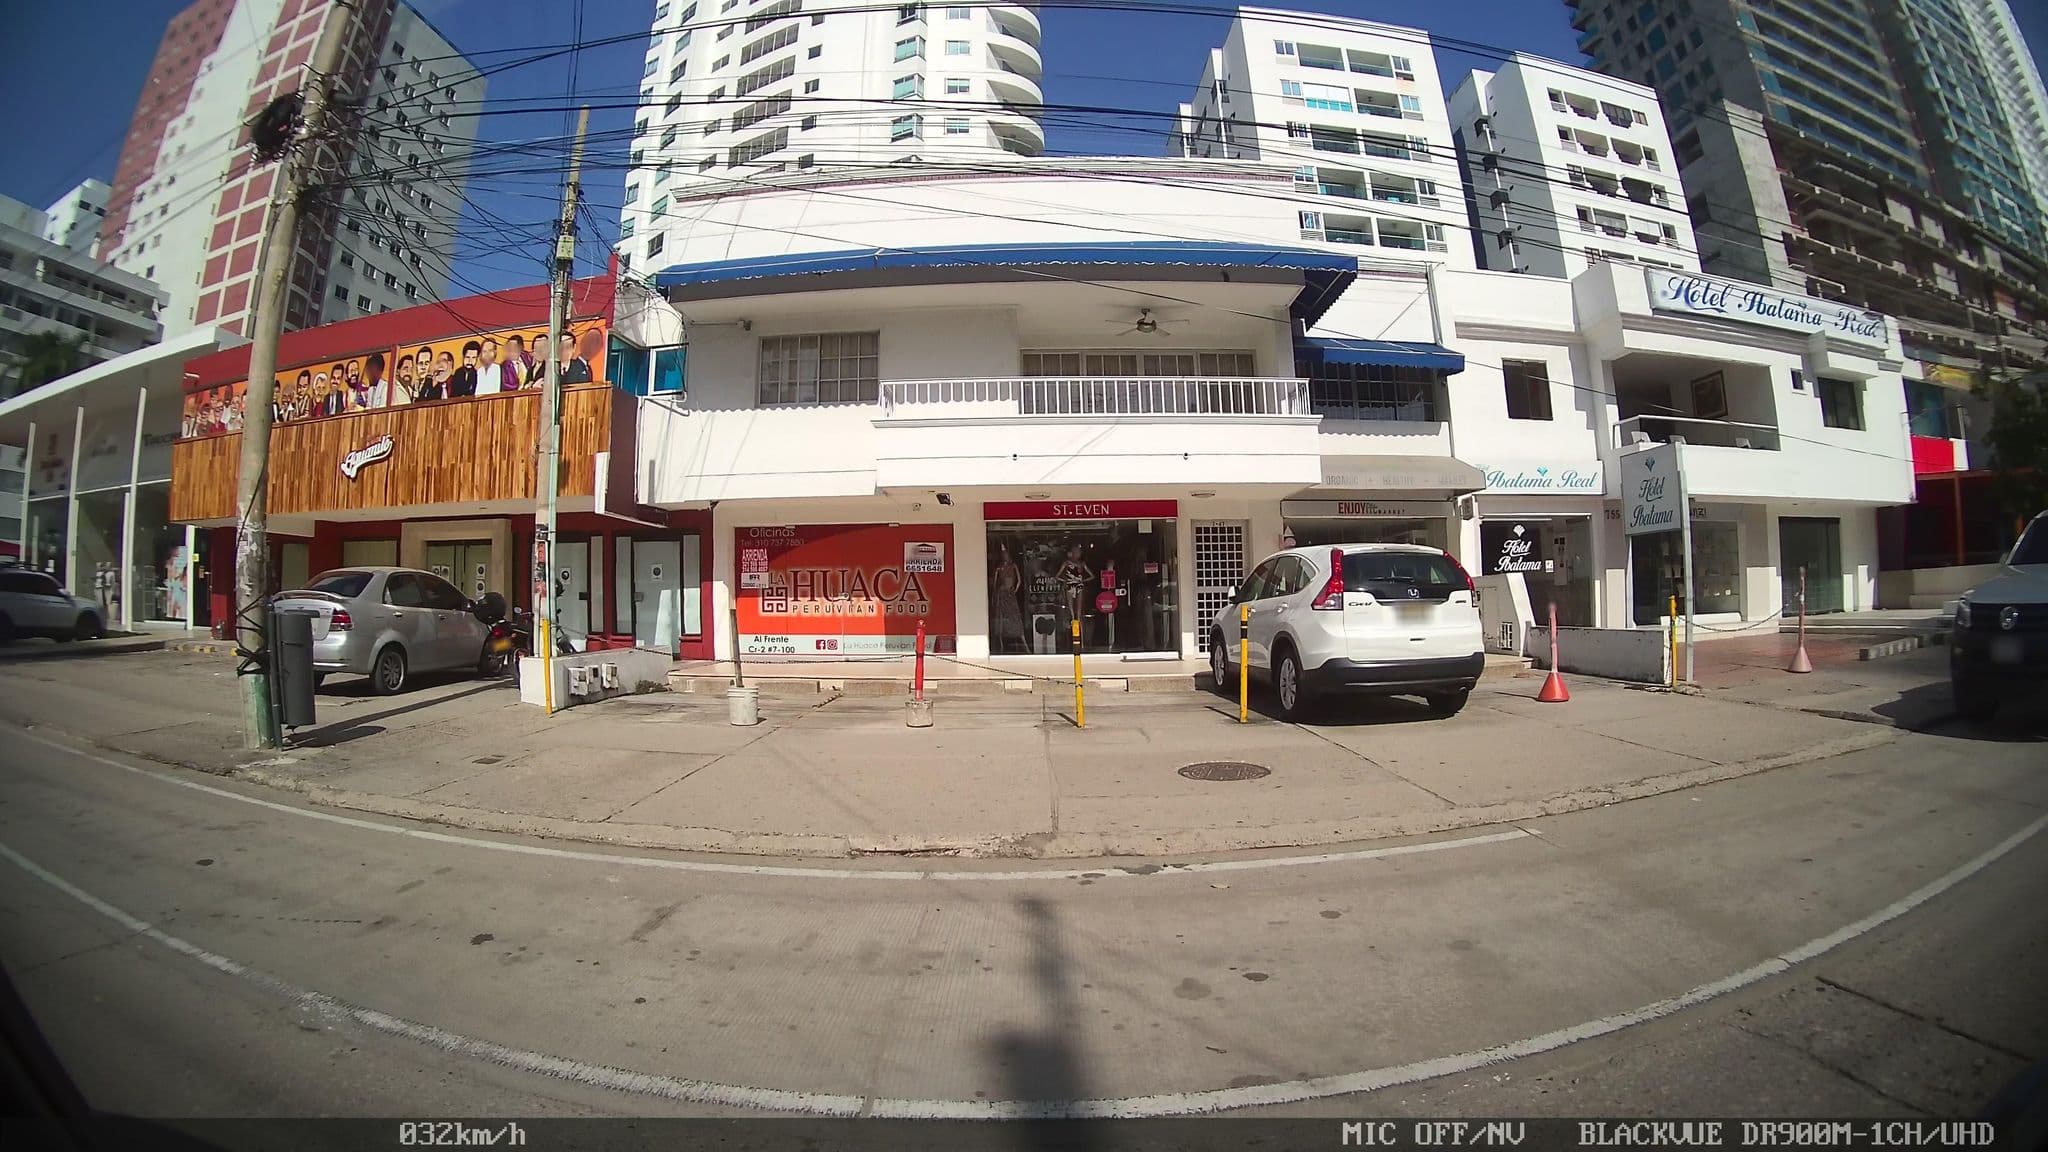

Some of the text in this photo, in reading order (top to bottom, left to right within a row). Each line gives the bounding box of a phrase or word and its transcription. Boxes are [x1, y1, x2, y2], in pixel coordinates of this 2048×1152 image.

[1662, 276, 1732, 315] Hotel
[1486, 470, 1598, 489] Ibatama Real
[1638, 476, 1665, 502] Hotel
[1629, 504, 1674, 528] Ibatama
[749, 527, 796, 539] Oficinas
[742, 548, 768, 561] ARRIENDA
[1501, 538, 1532, 556] Hotel
[1494, 556, 1541, 571] Ibatama
[769, 568, 928, 603] LA HUACA
[792, 603, 929, 614] PERUVIAN FOOD
[764, 635, 789, 644] Frente
[853, 640, 879, 649] Huaca
